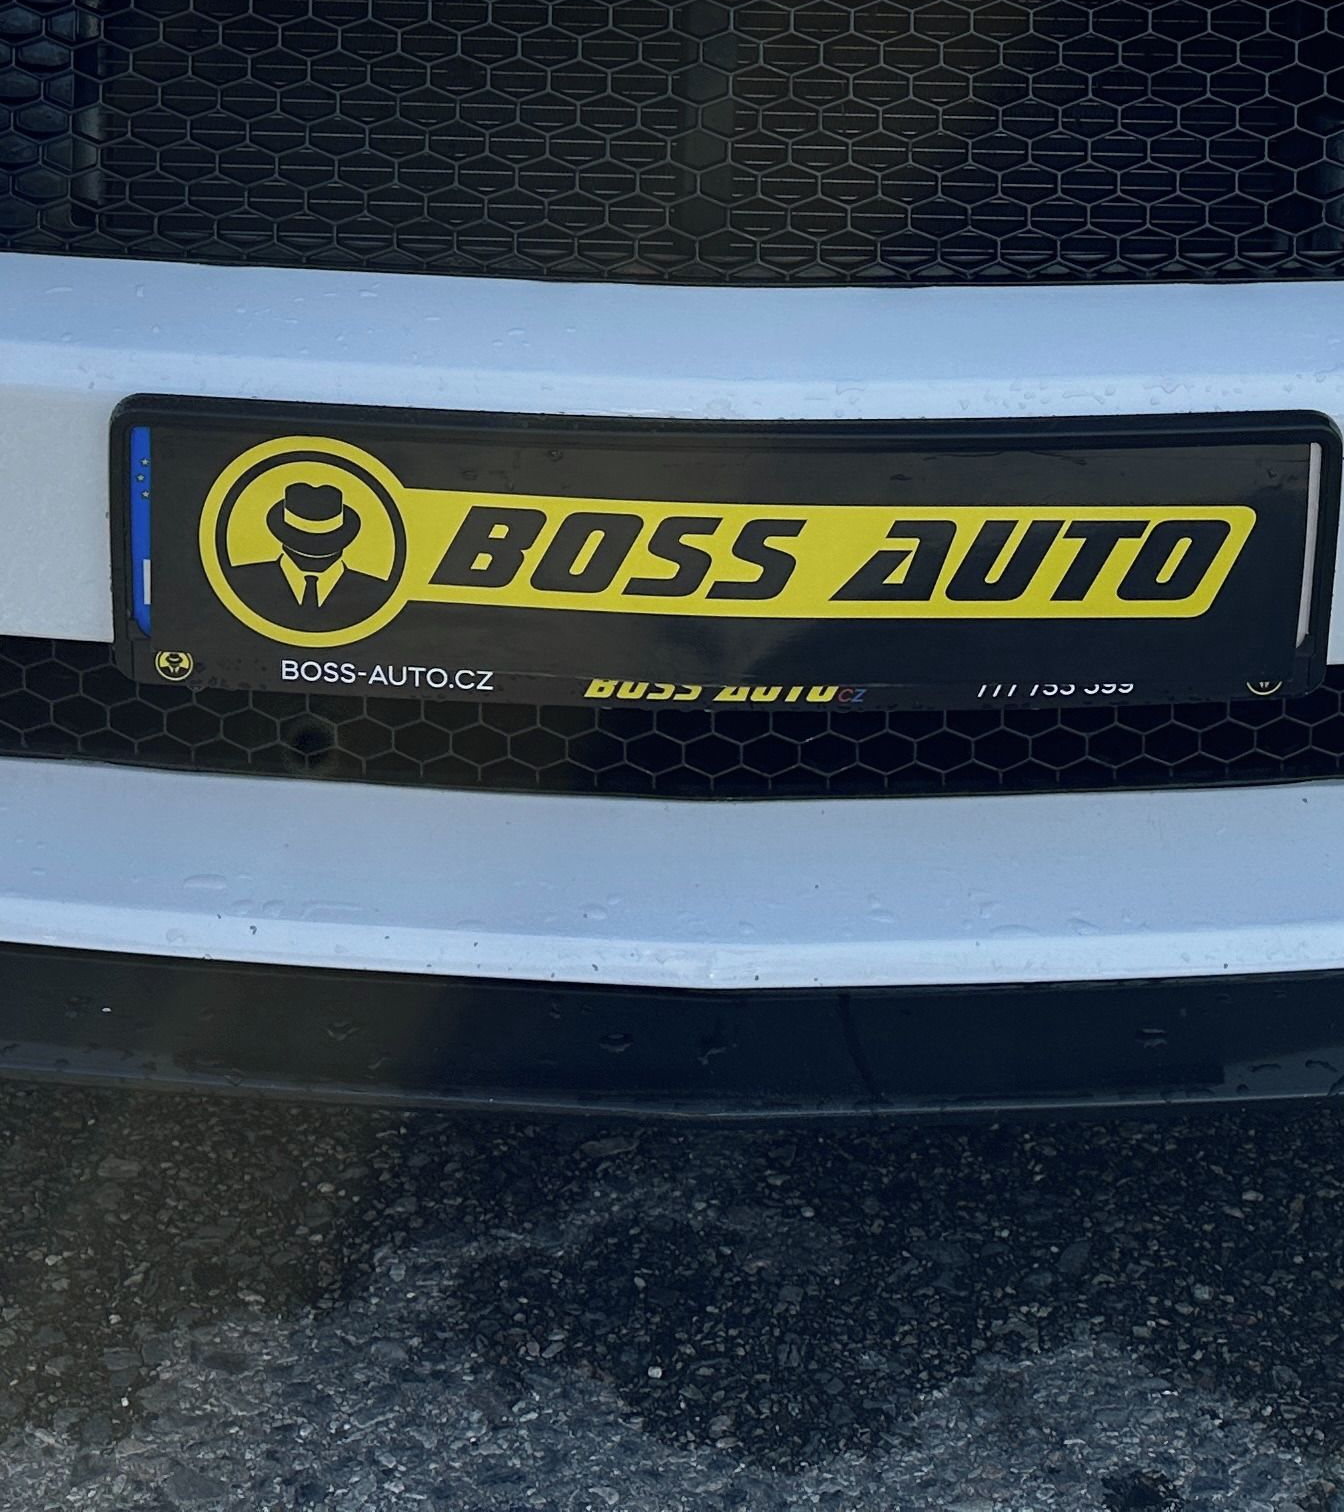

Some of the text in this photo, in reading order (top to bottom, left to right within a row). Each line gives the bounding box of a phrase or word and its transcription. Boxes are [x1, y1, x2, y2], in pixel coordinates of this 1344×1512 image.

[429, 506, 1232, 602] BOSS AUTO
[281, 659, 494, 691] BOSS-AUTO.CZ
